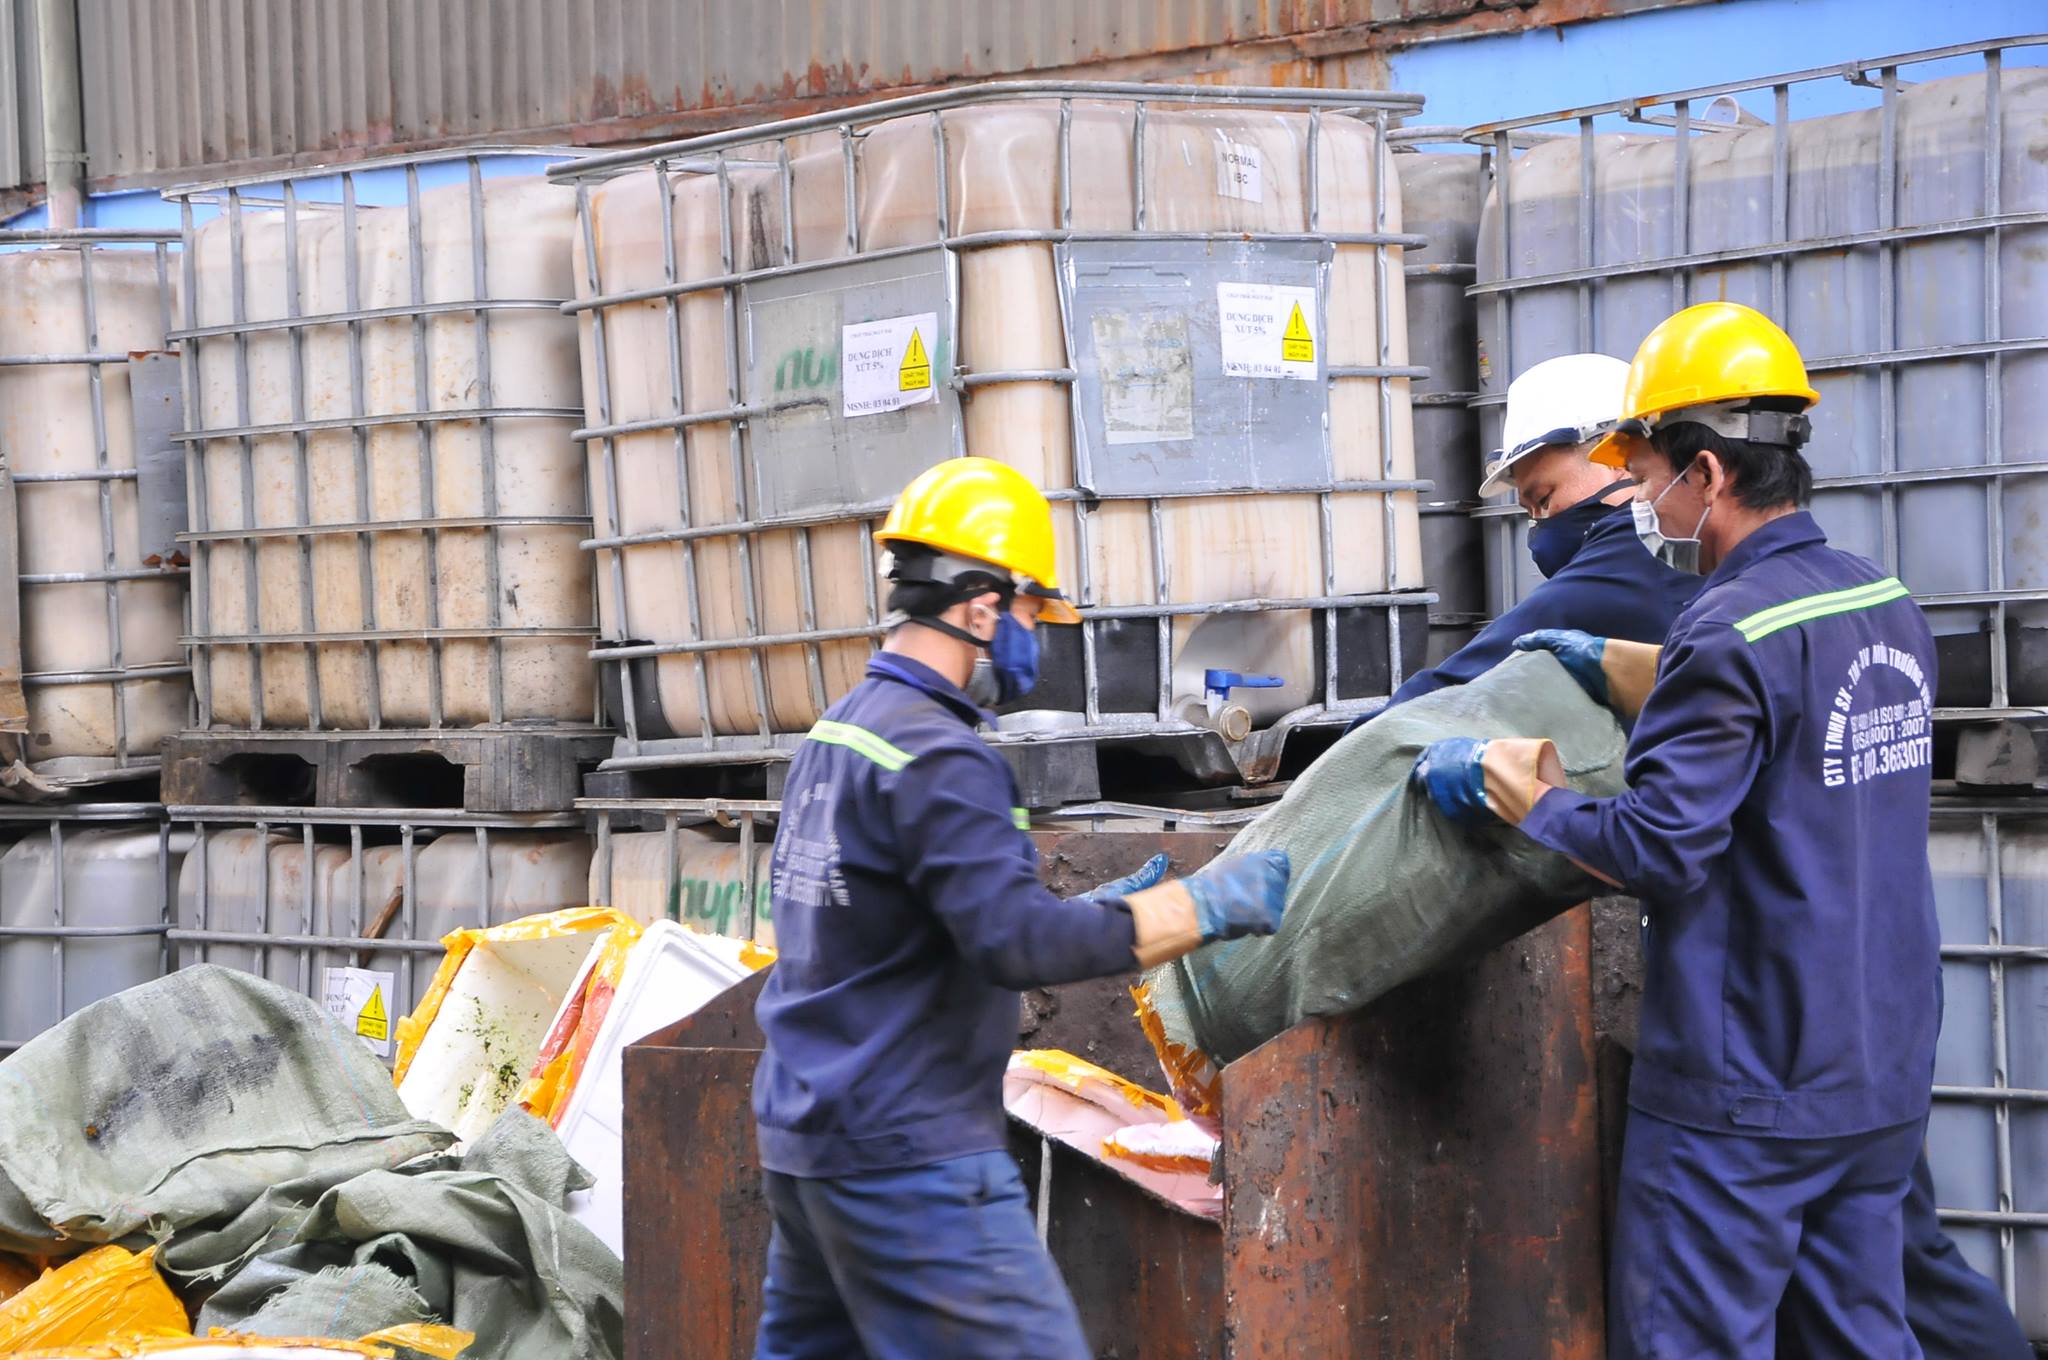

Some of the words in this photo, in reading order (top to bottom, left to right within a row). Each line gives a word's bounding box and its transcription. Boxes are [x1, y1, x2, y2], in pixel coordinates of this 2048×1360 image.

[1221, 152, 1258, 168] NORMAL
[1834, 687, 1853, 712] SX
[1824, 711, 1847, 752] TNHH
[1824, 757, 1846, 787] CTY
